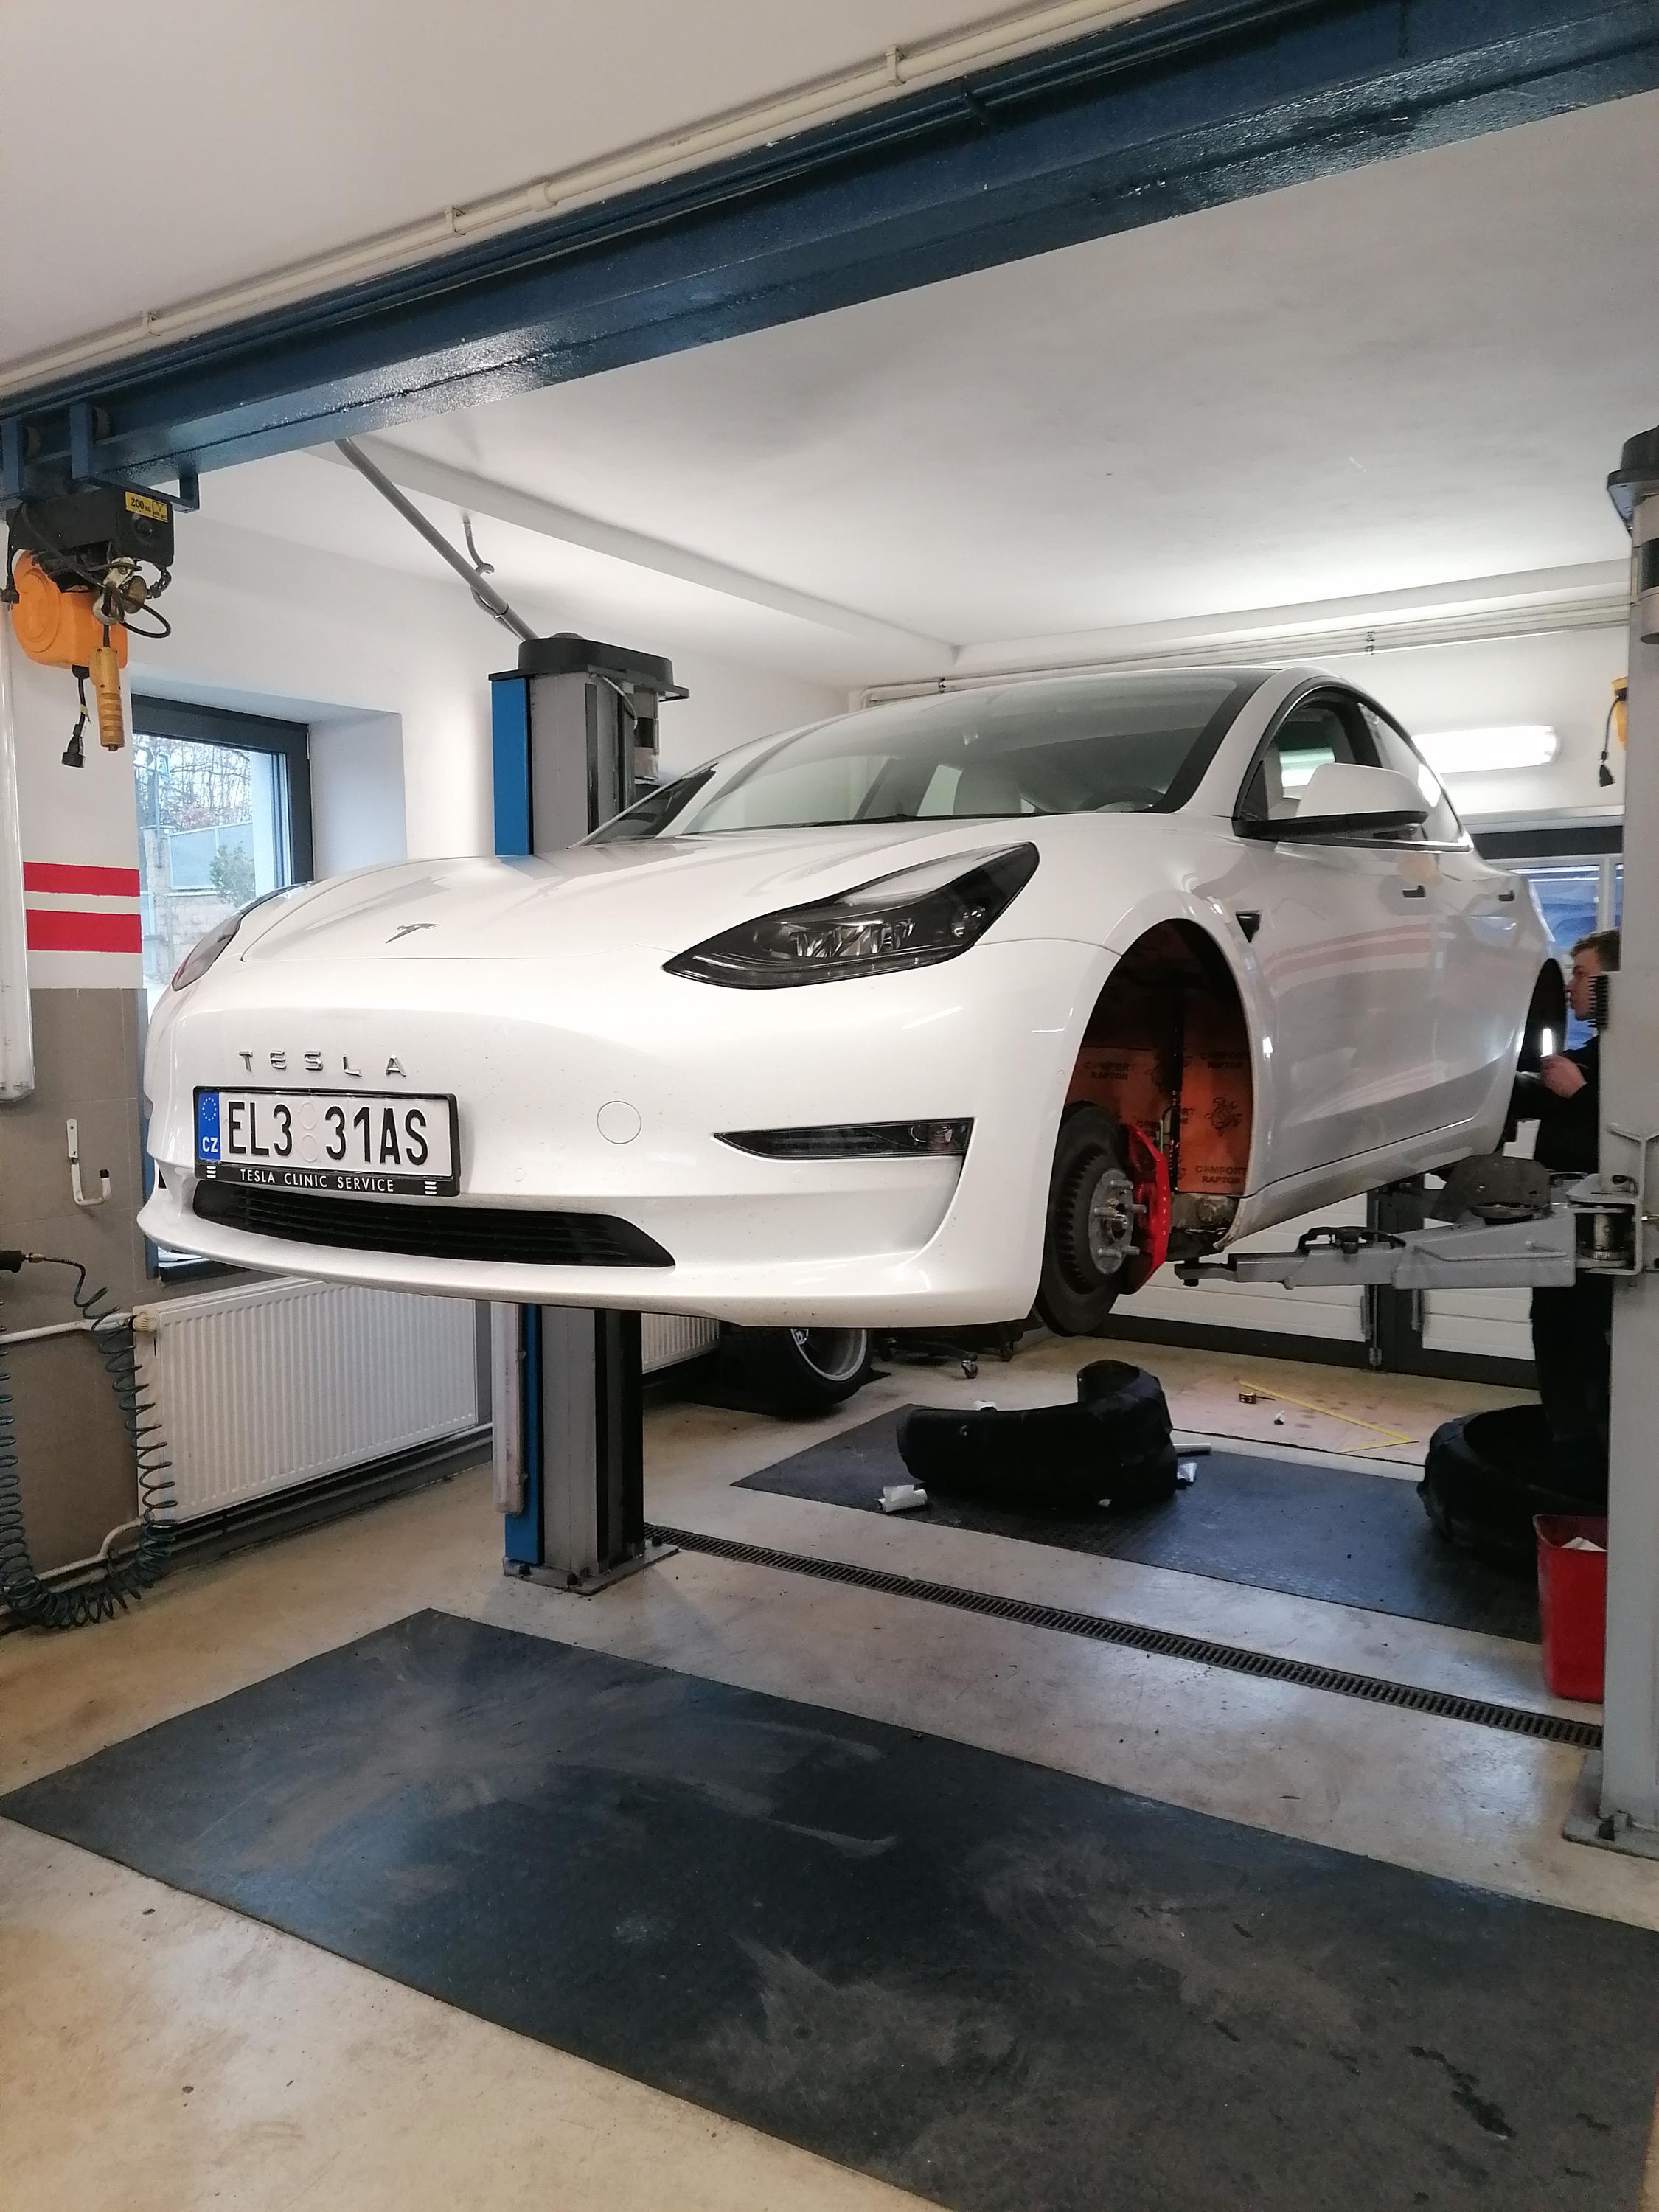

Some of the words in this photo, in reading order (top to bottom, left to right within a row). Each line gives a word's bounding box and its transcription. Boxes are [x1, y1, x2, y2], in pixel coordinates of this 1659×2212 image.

[131, 498, 145, 509] 200
[238, 1051, 406, 1077] TESLA
[1091, 1071, 1128, 1081] RAPTOR
[228, 1101, 293, 1158] EL3
[324, 1105, 429, 1166] 31AS
[202, 1136, 218, 1152] CZ
[240, 1169, 276, 1184] TESLA
[284, 1172, 327, 1189] CLINIC
[337, 1176, 394, 1192] SERVICE
[1202, 1175, 1242, 1184] RAPTOR
